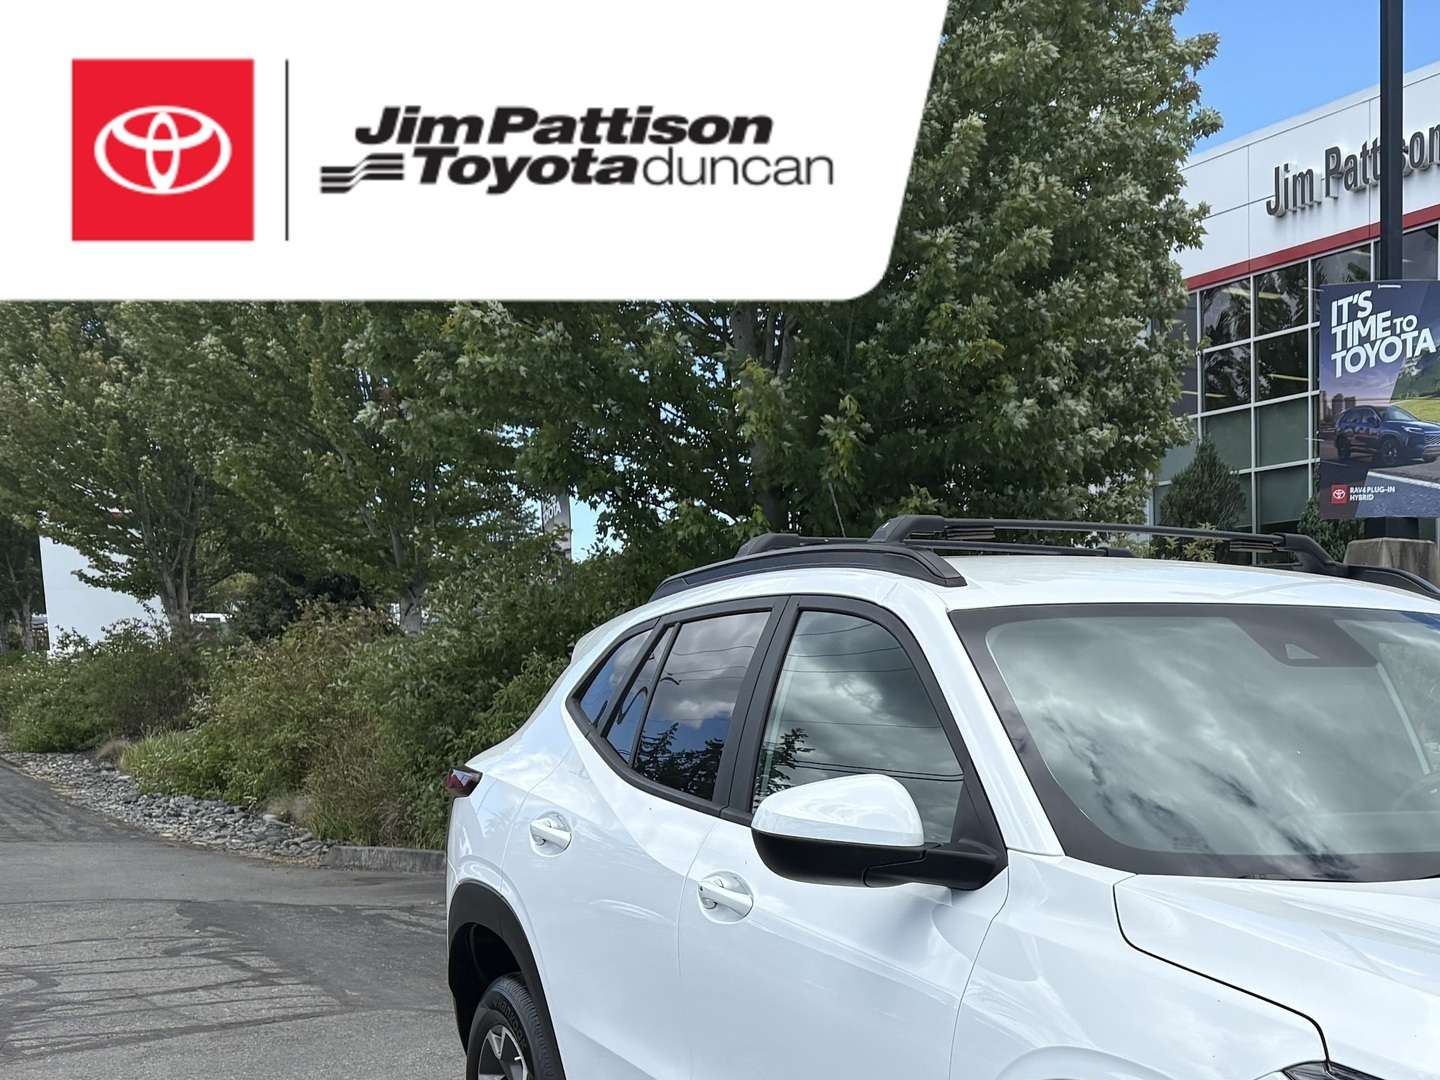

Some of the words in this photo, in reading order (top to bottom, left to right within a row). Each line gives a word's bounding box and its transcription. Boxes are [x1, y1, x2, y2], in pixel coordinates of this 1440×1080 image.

[1266, 163, 1315, 216] Jim
[1331, 290, 1374, 328] IT'S
[1331, 310, 1392, 352] TIME
[1393, 314, 1418, 335] TO
[1330, 327, 1437, 379] TOYOTA
[1349, 493, 1375, 501] HYBRID
[1366, 484, 1396, 494] PLUG-IN
